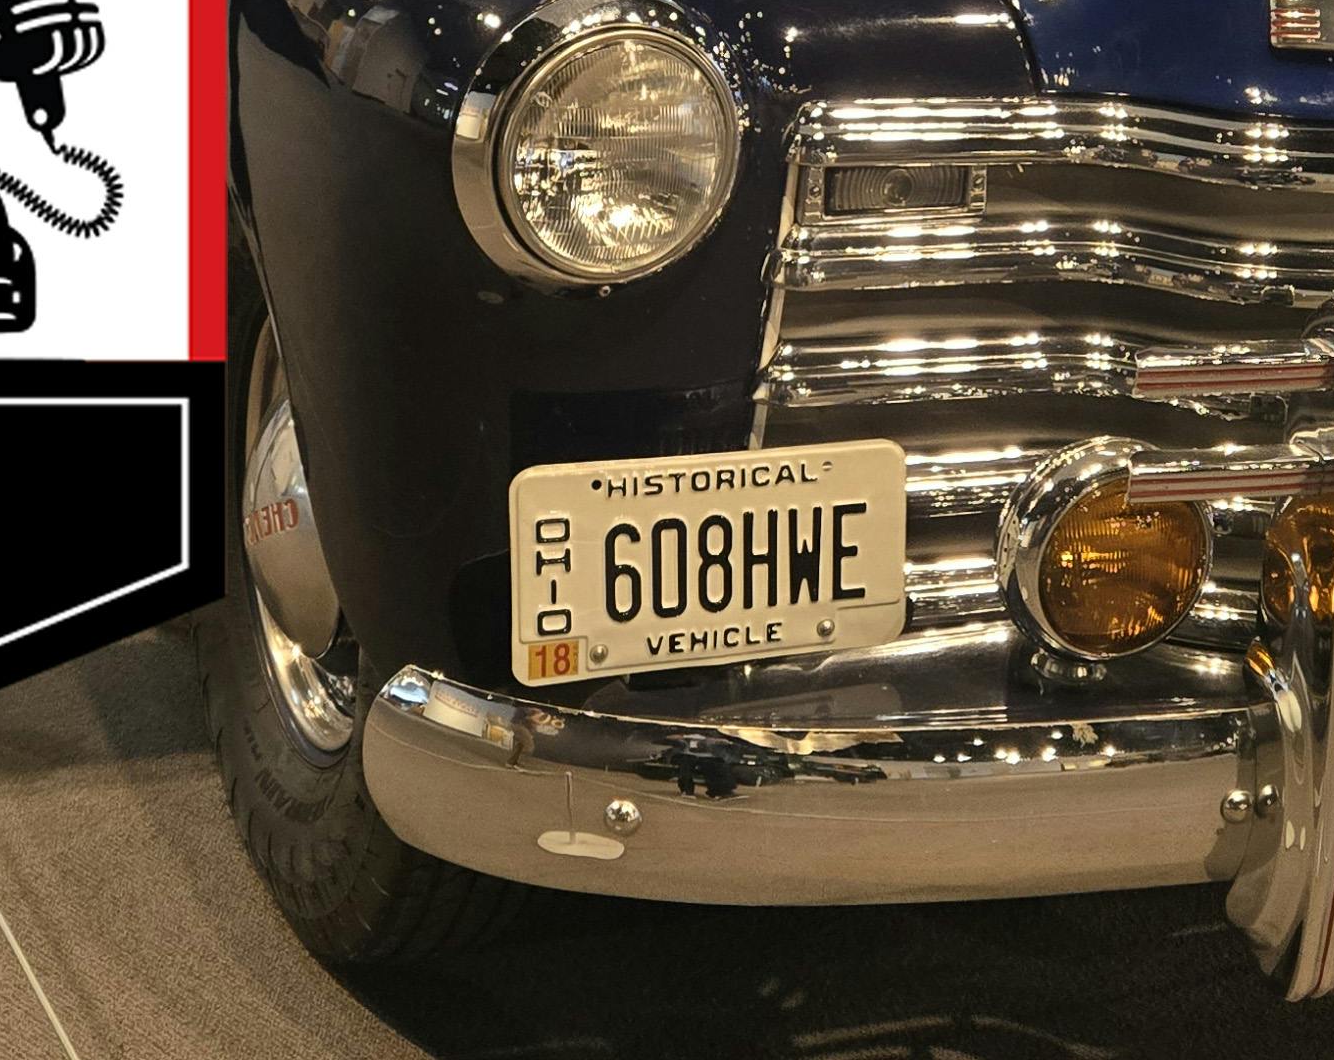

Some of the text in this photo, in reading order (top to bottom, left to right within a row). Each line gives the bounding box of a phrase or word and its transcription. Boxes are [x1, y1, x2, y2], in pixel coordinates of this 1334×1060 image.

[607, 462, 819, 499] HISTORICAL
[535, 517, 572, 637] OHIO
[604, 501, 868, 623] 608HWE
[646, 621, 784, 657] VEHICLE
[535, 642, 571, 678] 18
